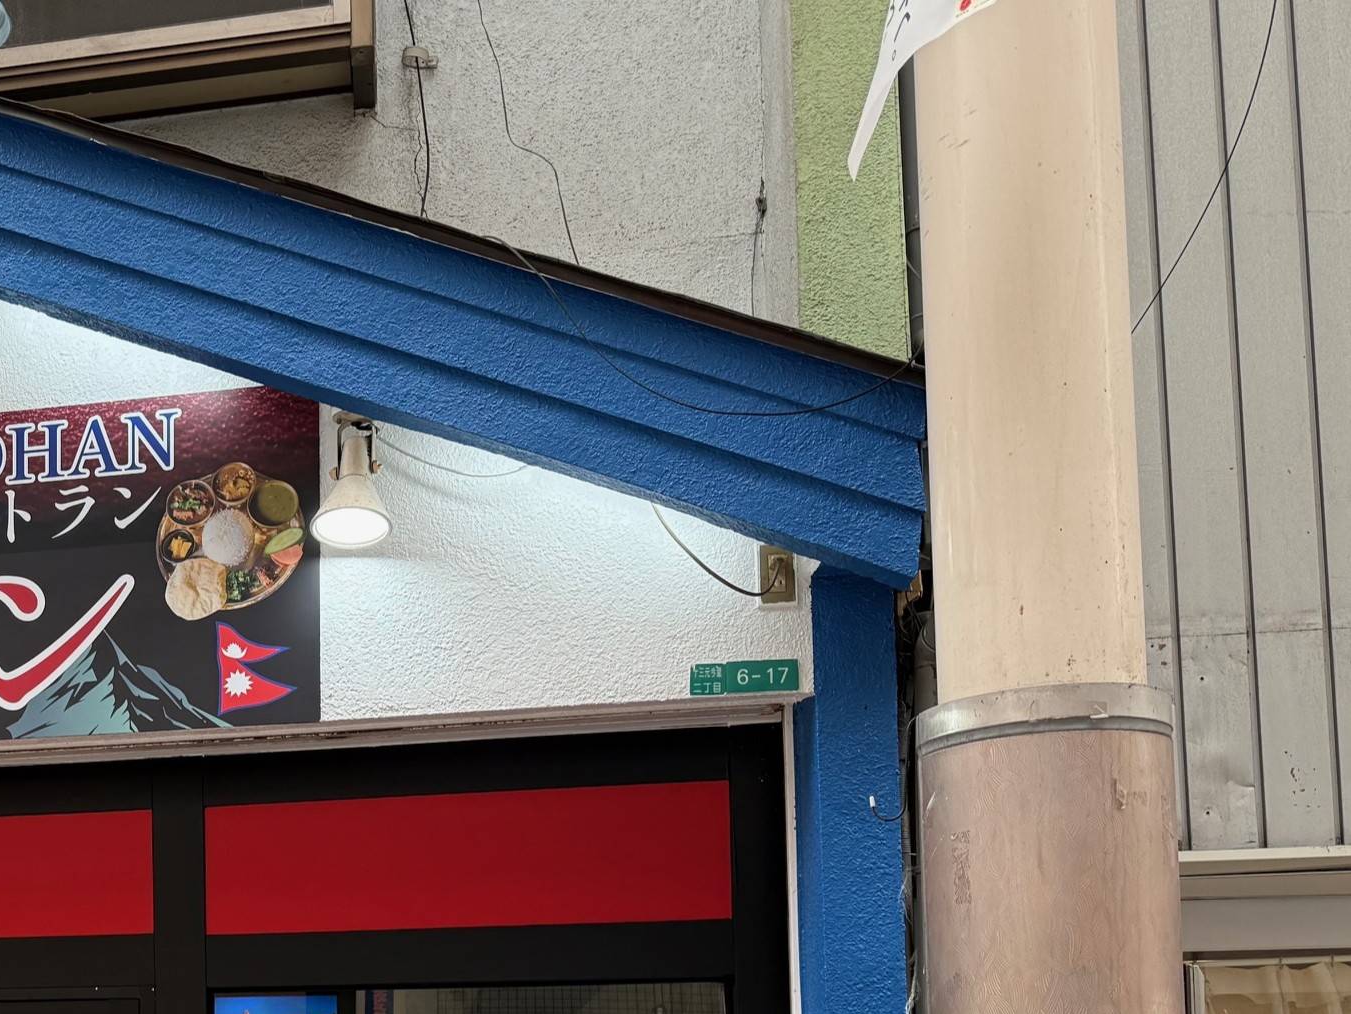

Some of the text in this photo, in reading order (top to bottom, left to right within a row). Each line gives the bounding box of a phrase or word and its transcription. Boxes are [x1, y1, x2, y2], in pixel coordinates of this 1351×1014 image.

[736, 666, 789, 686] 6-17
[692, 681, 722, 694] 二丁目
